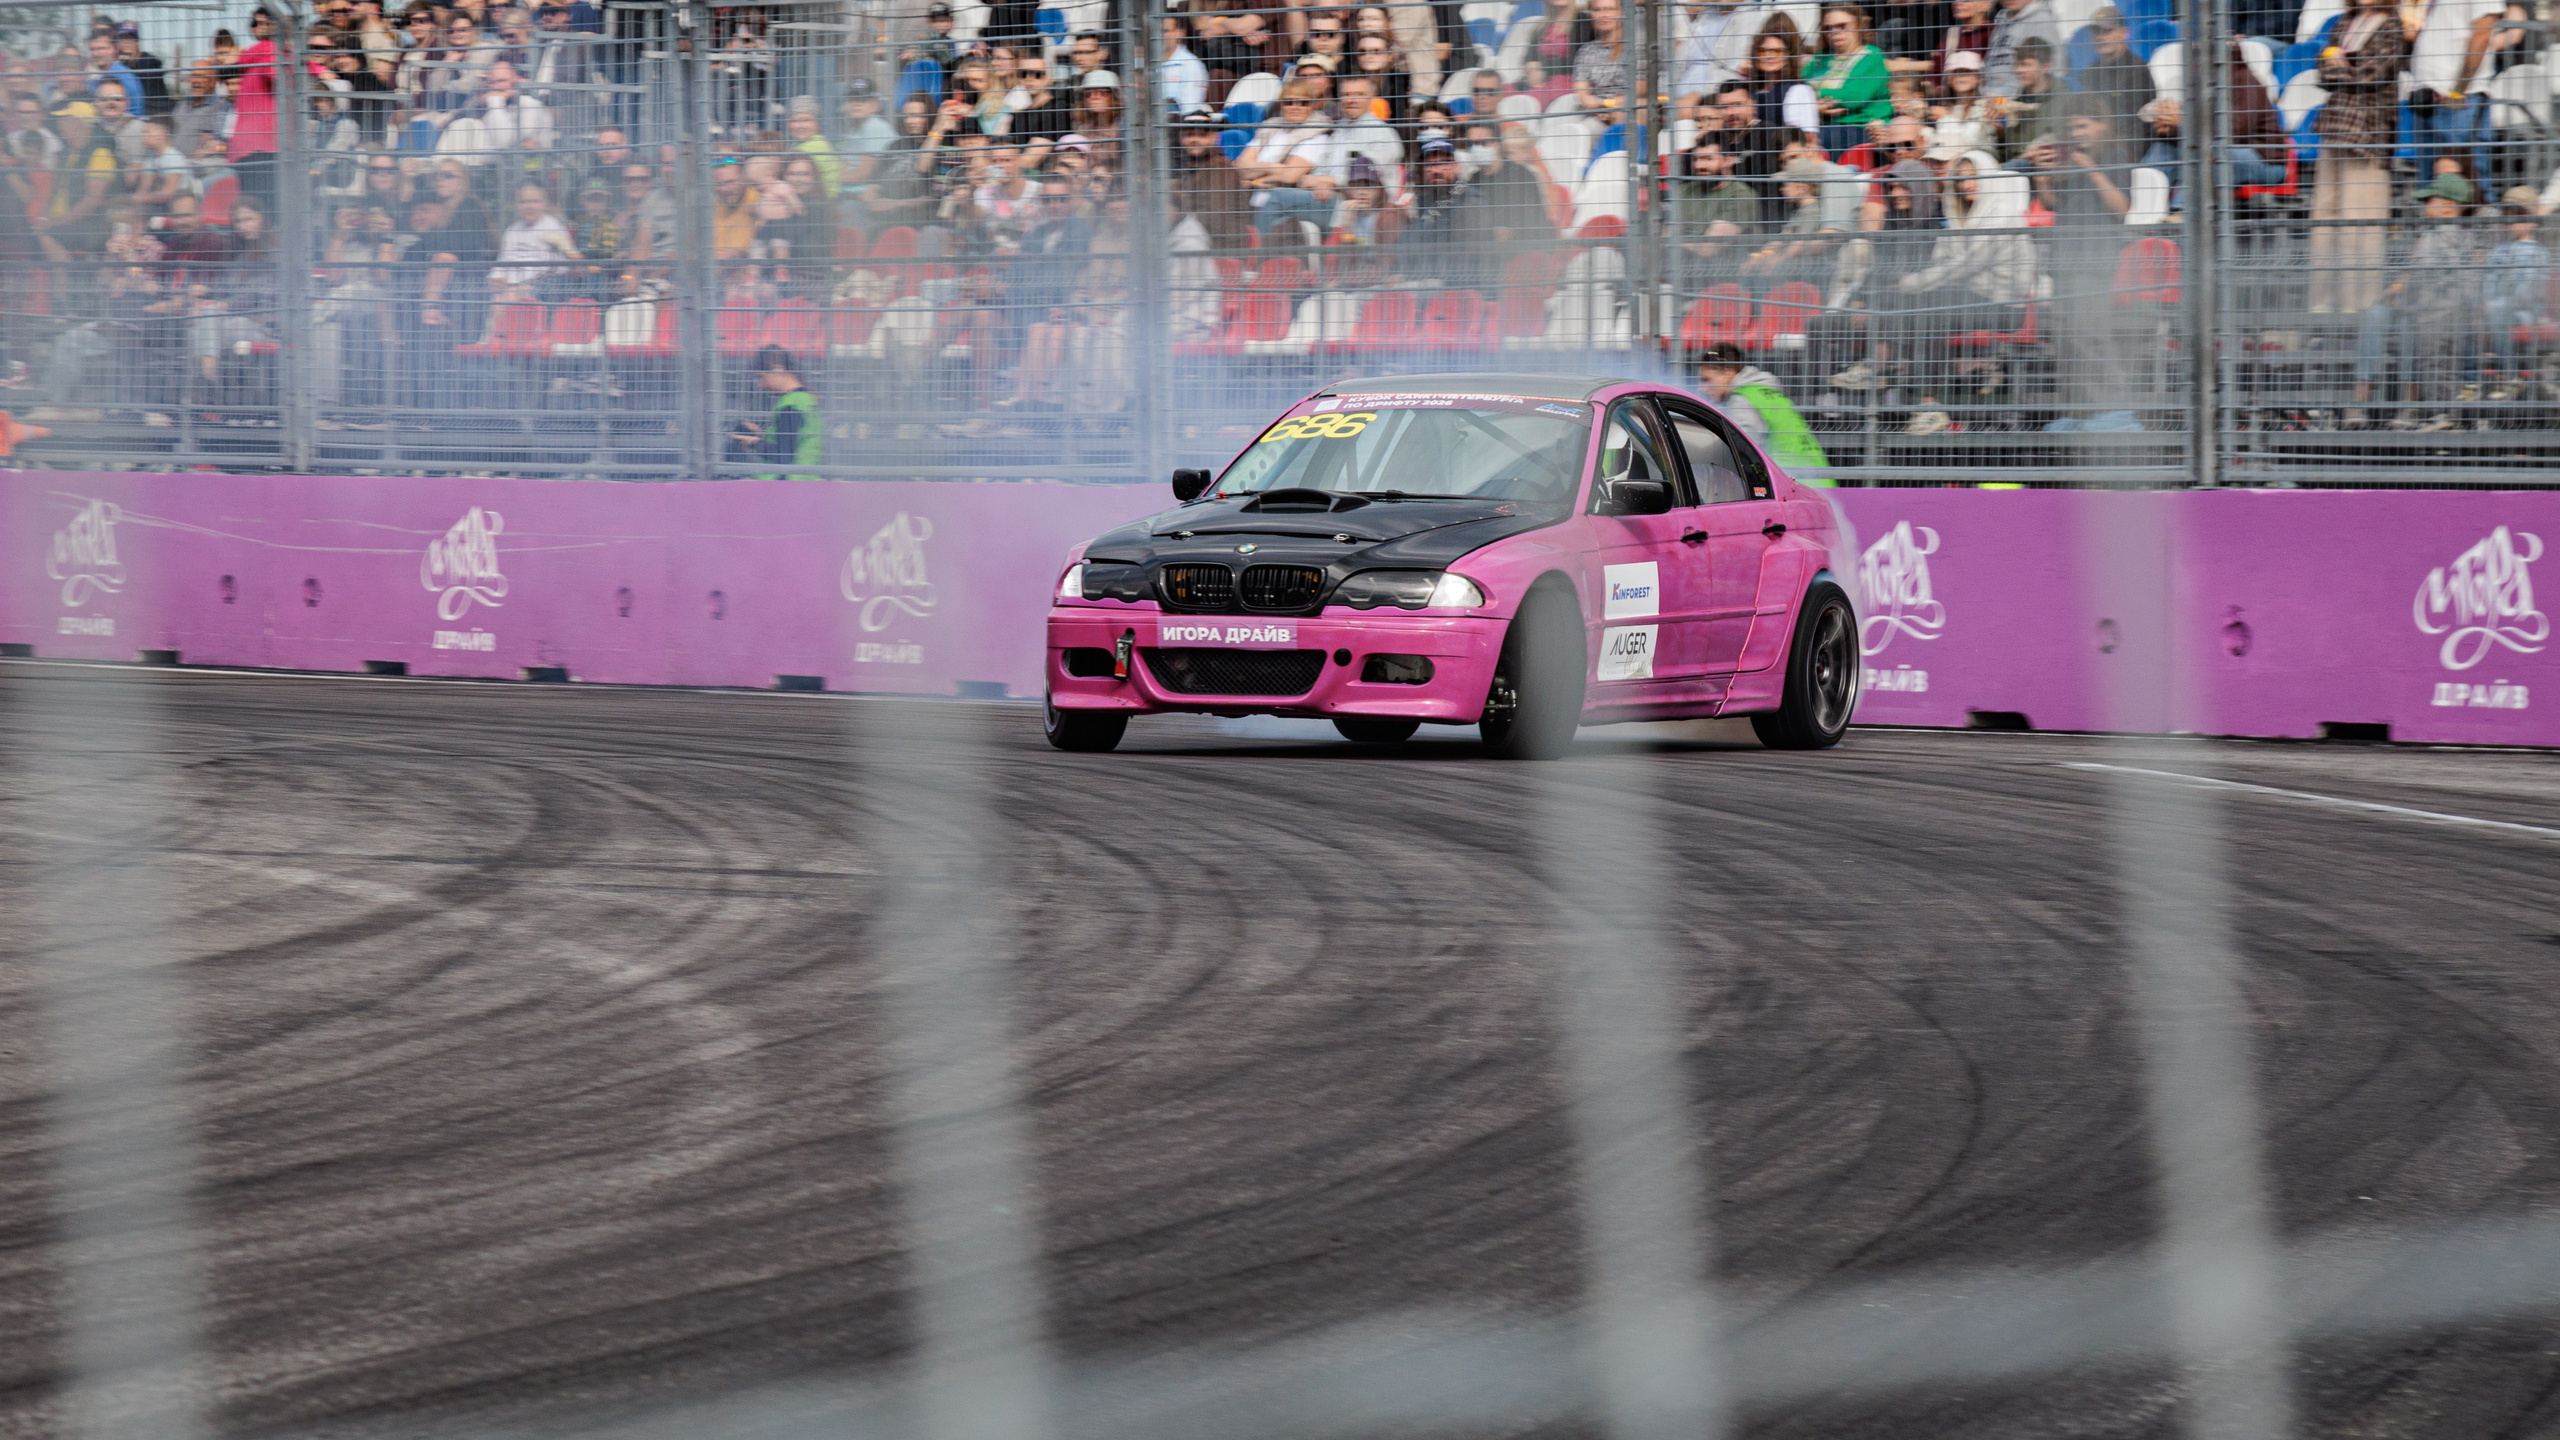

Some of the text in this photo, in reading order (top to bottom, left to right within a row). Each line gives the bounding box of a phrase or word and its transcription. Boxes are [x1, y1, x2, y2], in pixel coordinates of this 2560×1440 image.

[1363, 400, 1420, 408] ДРИФТУ
[1260, 413, 1378, 443] 686
[1612, 583, 1650, 601] KINFOREST
[1163, 625, 1291, 643] ИГОРА ДРАЙВ
[1609, 632, 1647, 656] AUGER
[2431, 678, 2530, 709] ДРАЙВ
